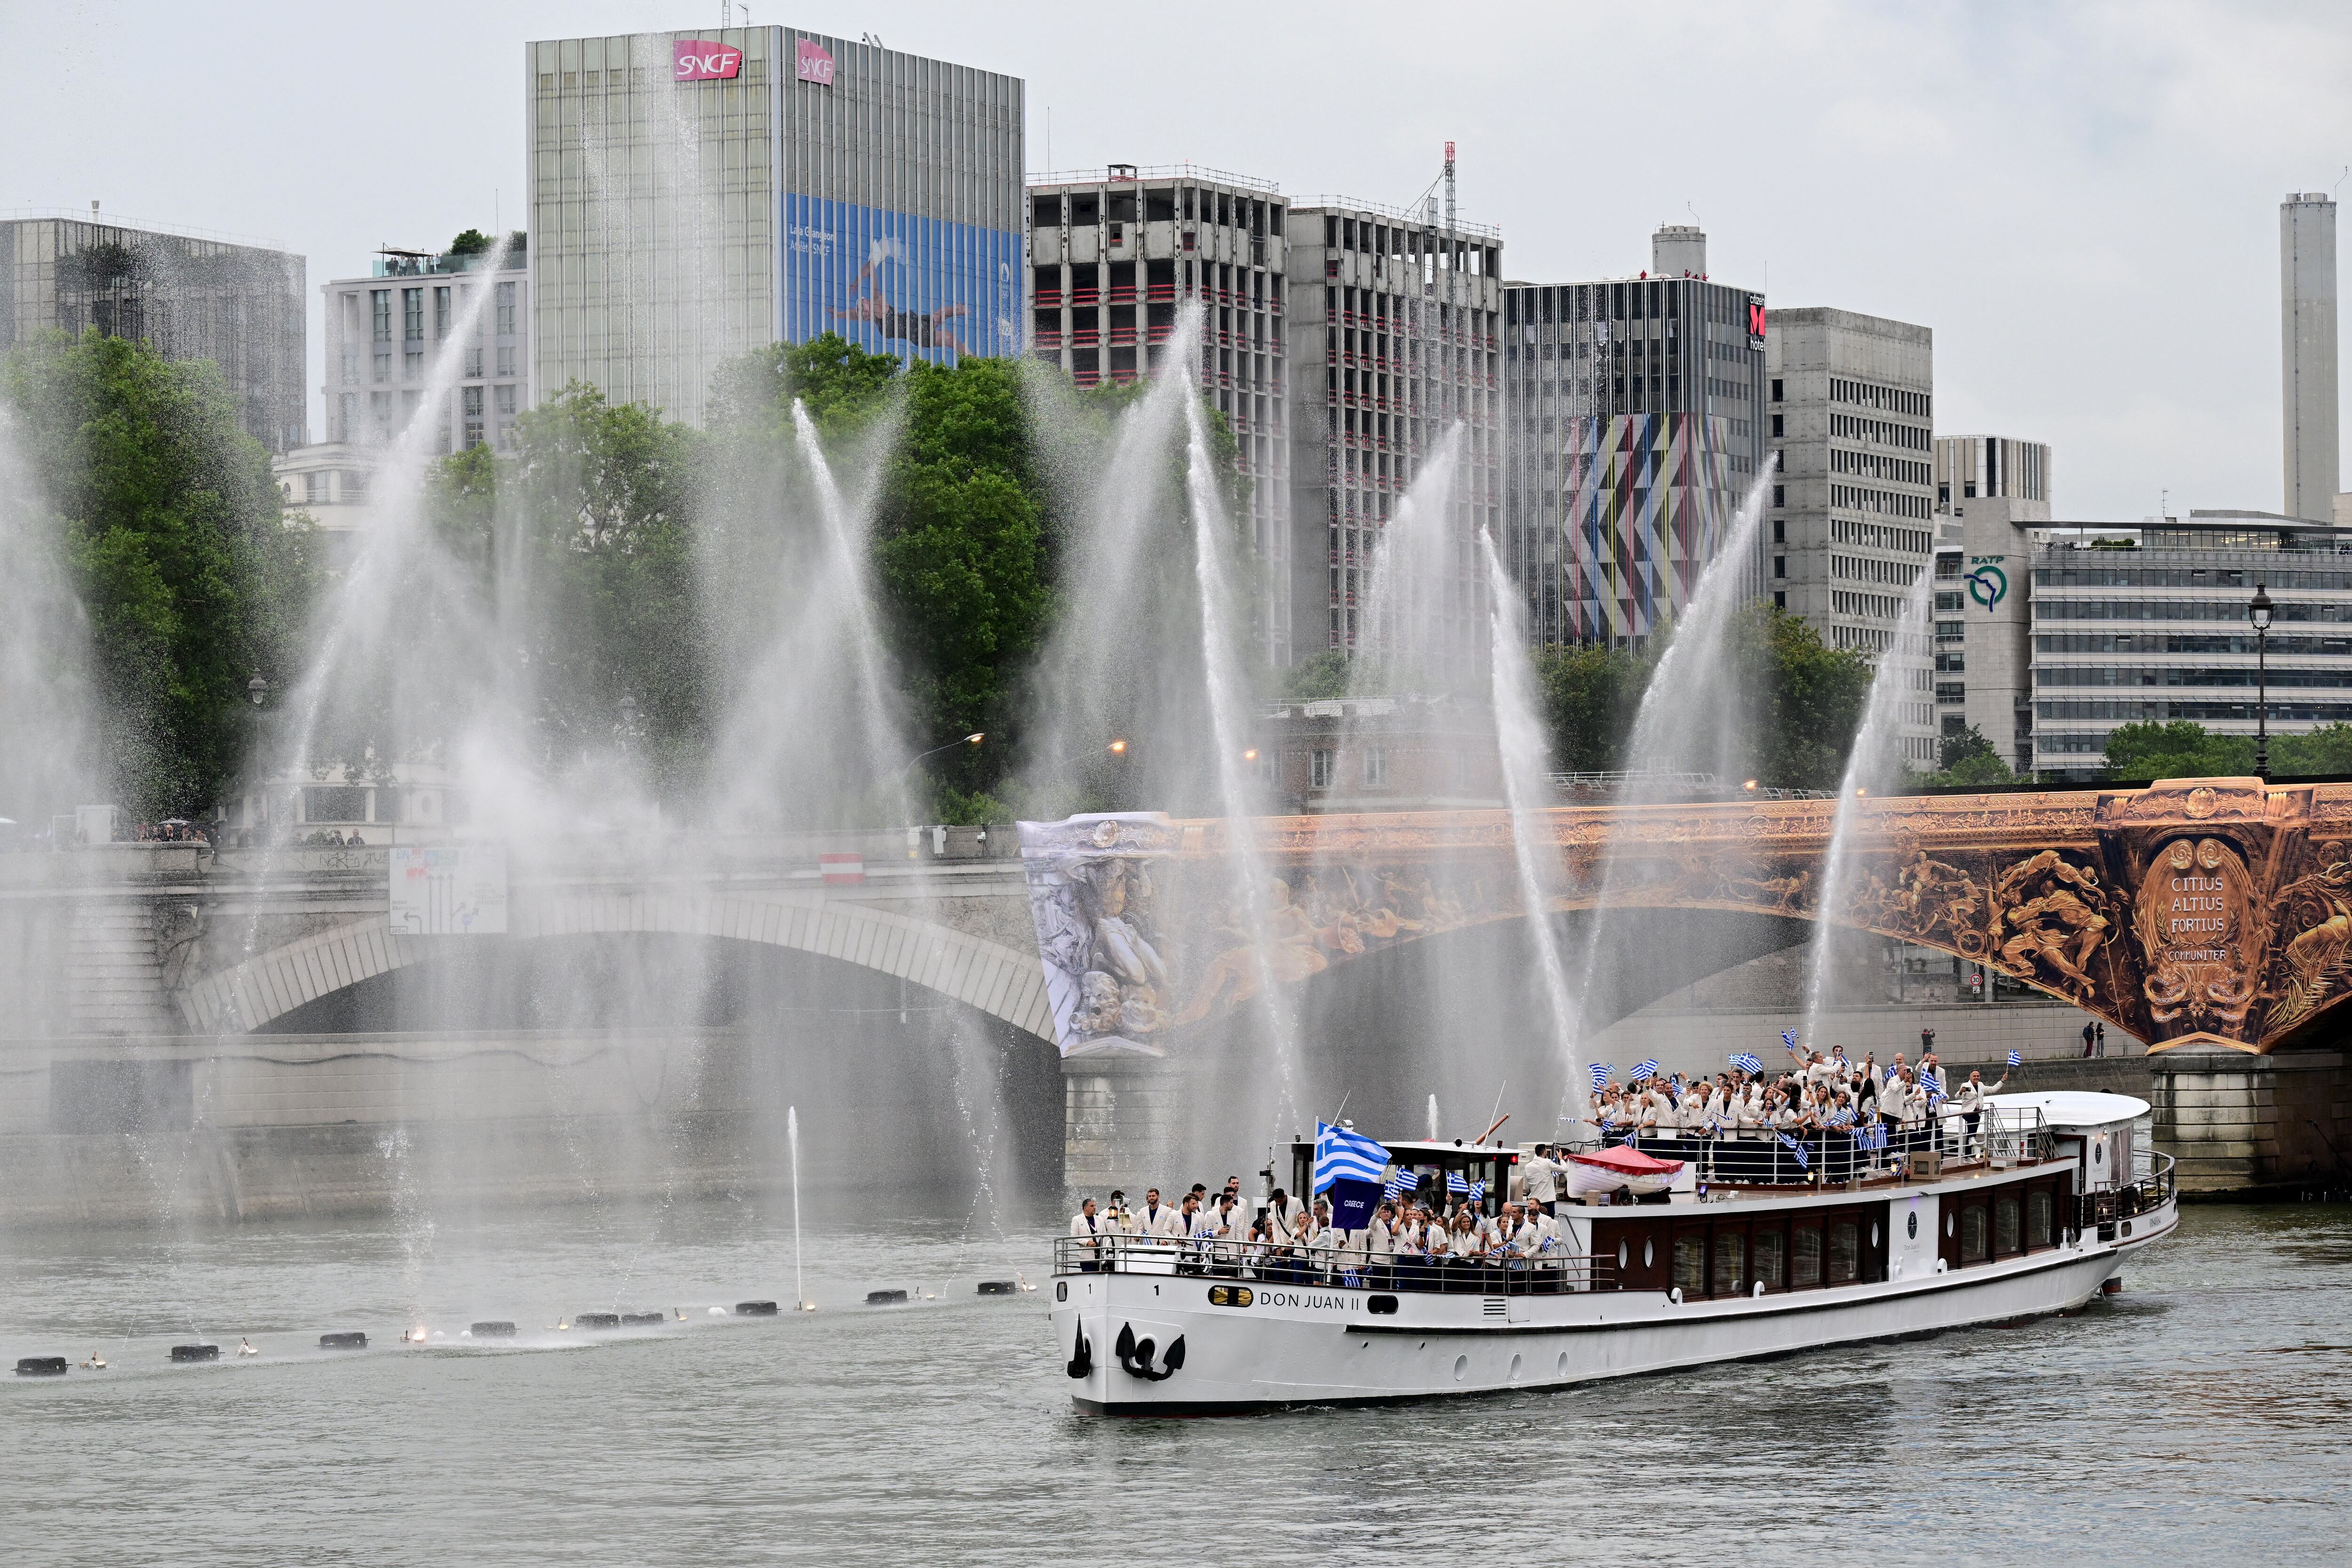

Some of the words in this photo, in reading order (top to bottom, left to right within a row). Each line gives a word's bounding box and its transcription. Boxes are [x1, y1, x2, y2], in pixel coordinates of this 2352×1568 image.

[677, 53, 737, 75] SNCF
[800, 56, 833, 78] SNCF
[1750, 294, 1765, 306] citizen
[1750, 336, 1765, 351] hotel
[2171, 877, 2224, 892] CITIUS
[2171, 897, 2224, 911] ALTIUS
[2171, 918, 2224, 933] FORTIUS
[2169, 949, 2226, 961] COMMUNITER
[2167, 984, 2184, 996] HIGHER
[2154, 1012, 2175, 1022] TOGETHER
[2218, 1010, 2241, 1020] ENSEMBLE
[1344, 1200, 1365, 1209] GREECE
[1089, 1283, 1091, 1294] 1
[1154, 1284, 1159, 1296] 1
[1261, 1292, 1299, 1306] DON
[1304, 1295, 1344, 1309] JUAN
[1351, 1297, 1359, 1310] II
